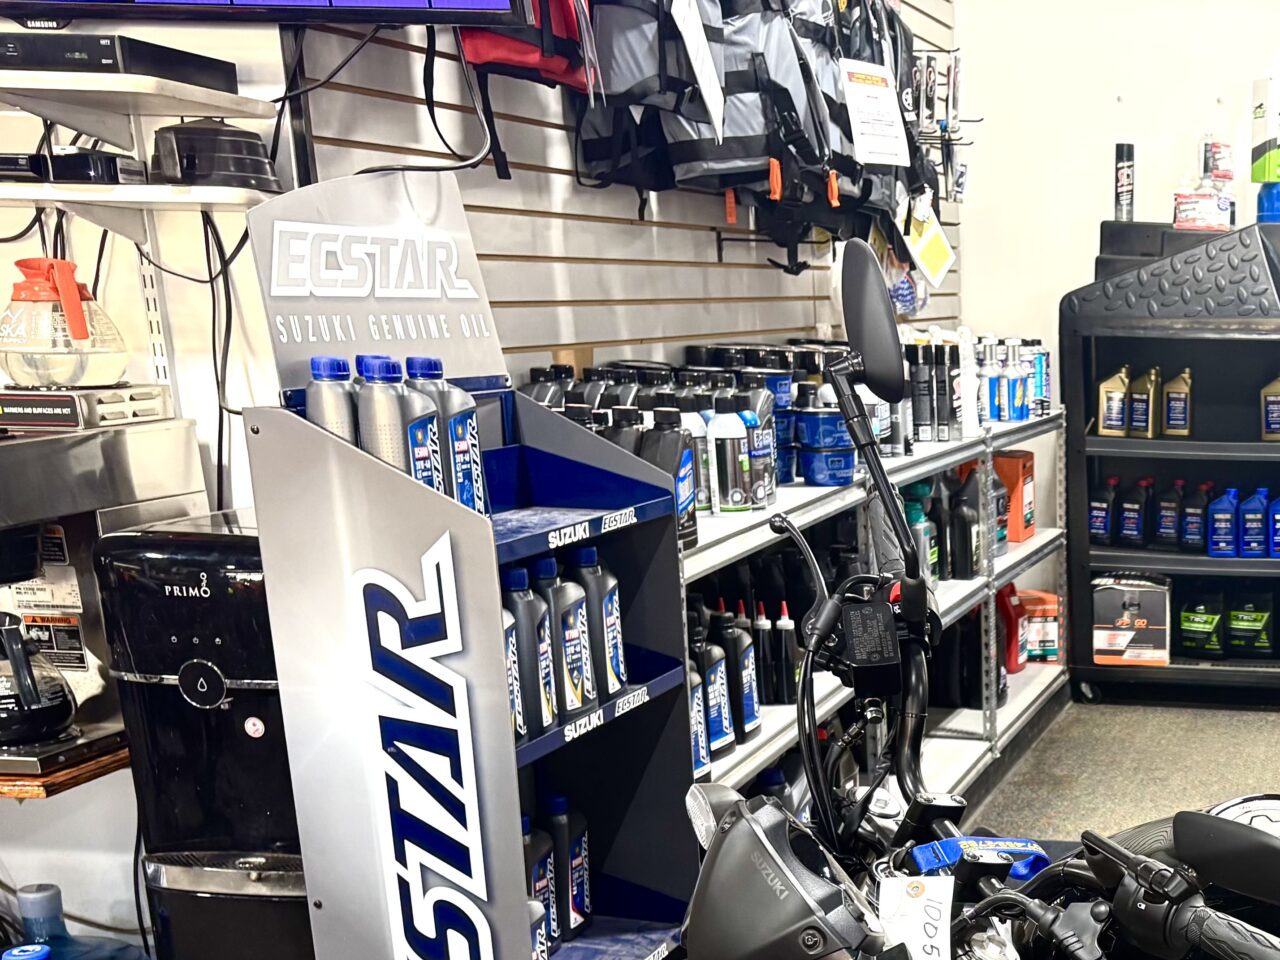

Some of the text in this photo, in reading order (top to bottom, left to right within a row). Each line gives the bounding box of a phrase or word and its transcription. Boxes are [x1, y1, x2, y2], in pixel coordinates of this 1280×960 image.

[27, 20, 57, 28] SAMSUNG
[272, 223, 478, 297] ECSTAR
[275, 313, 490, 343] SUZUKI GENUINE OIL
[548, 507, 637, 549] SUZUKI ECSTAR
[164, 583, 211, 598] PRIMO
[563, 687, 650, 742] SUZUKI ECSTAR
[750, 850, 789, 901] SUZUKI
